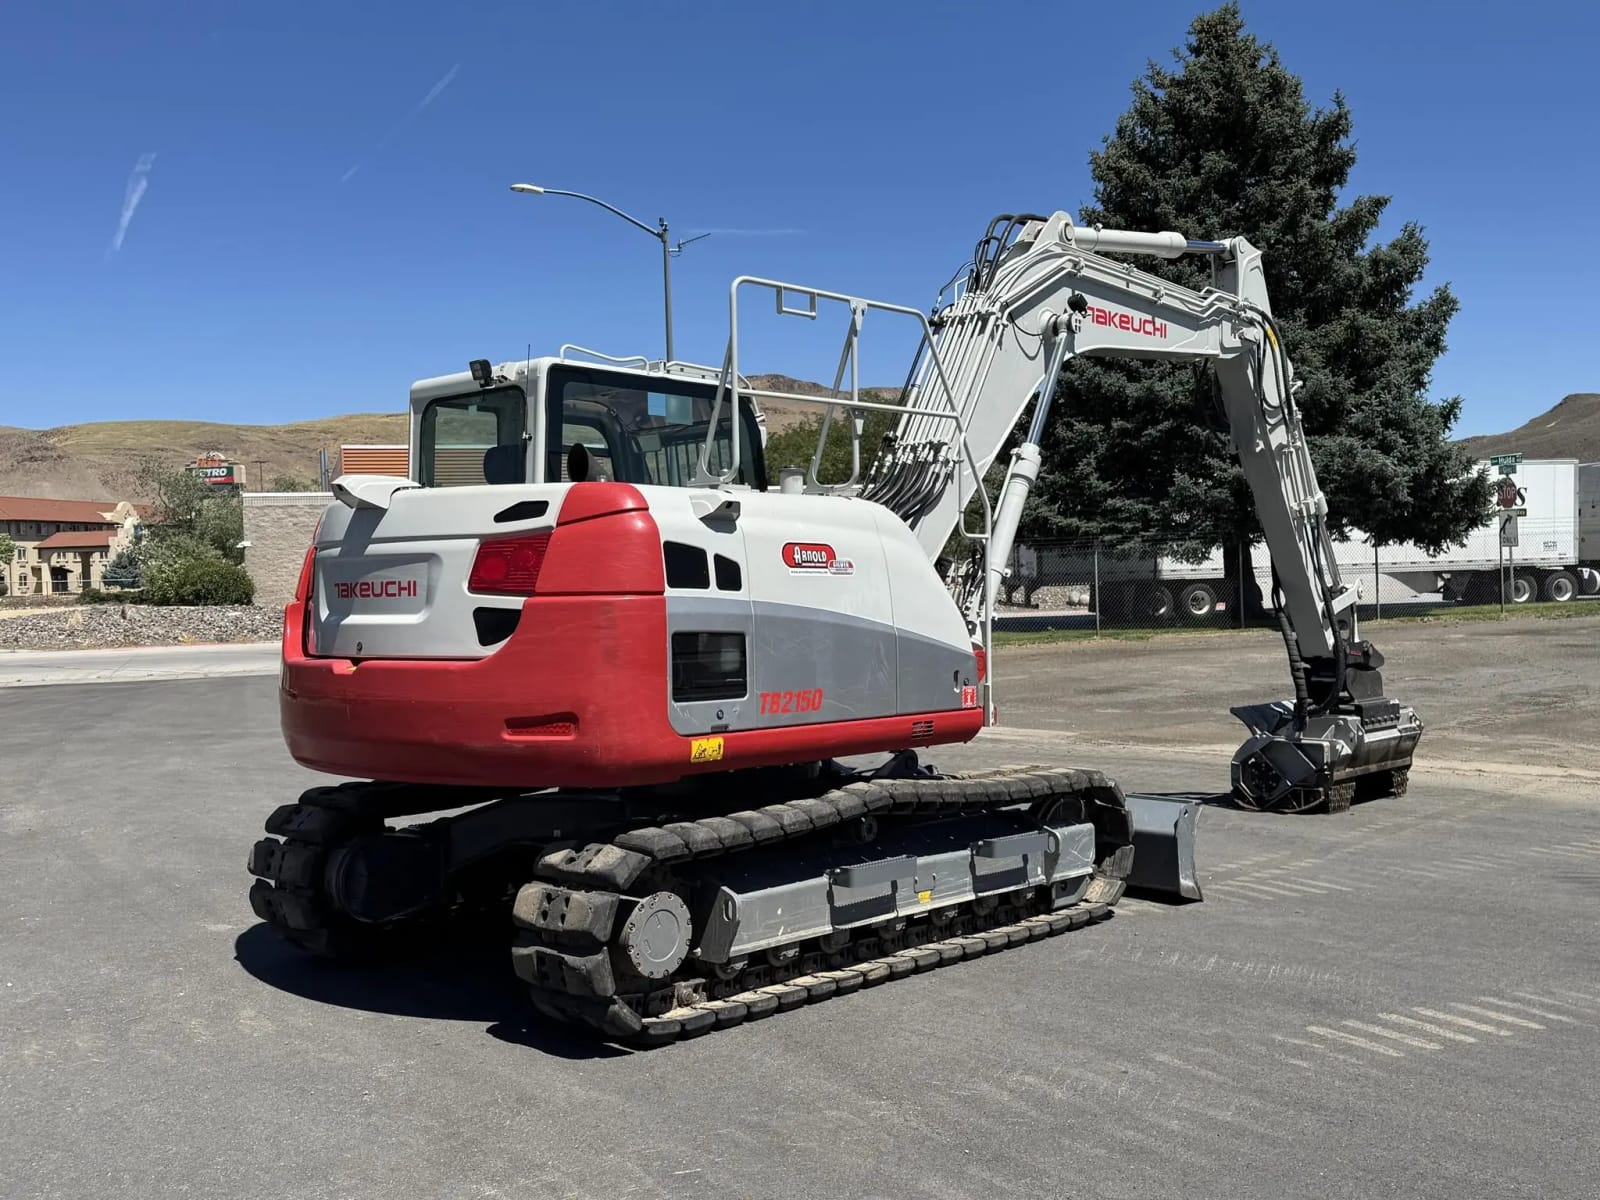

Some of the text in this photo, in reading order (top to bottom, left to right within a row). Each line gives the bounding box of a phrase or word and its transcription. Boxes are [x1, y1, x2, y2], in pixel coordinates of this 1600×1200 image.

[1500, 486, 1516, 499] STOP
[1502, 536, 1517, 545] ONLY
[759, 688, 823, 715] TB2150
